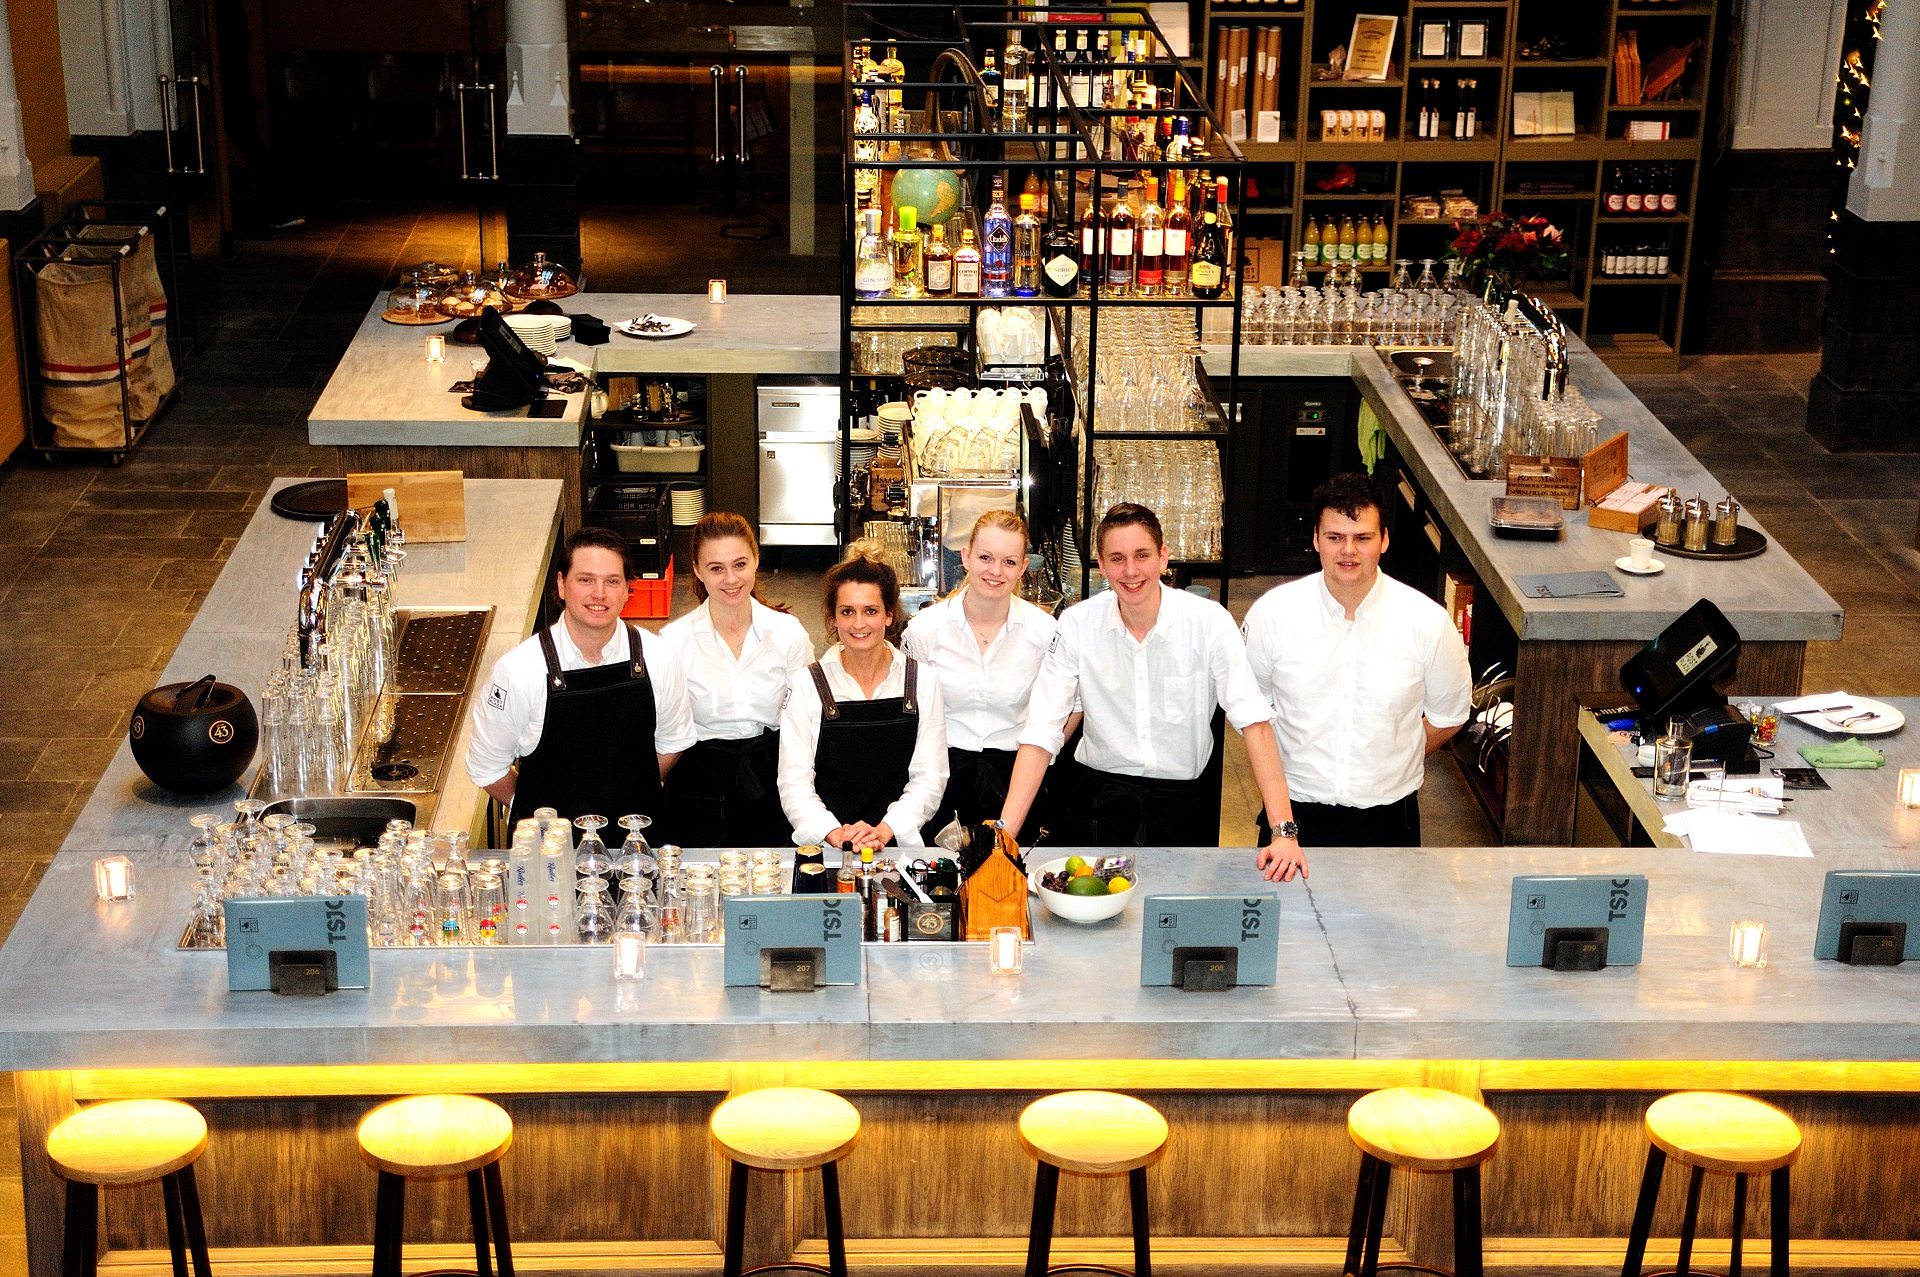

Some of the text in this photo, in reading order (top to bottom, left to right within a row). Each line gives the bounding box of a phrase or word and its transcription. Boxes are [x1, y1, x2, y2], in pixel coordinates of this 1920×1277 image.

[214, 725, 229, 738] 43
[1582, 944, 1597, 952] 209
[305, 968, 320, 976] 206
[1209, 965, 1224, 973] 208
